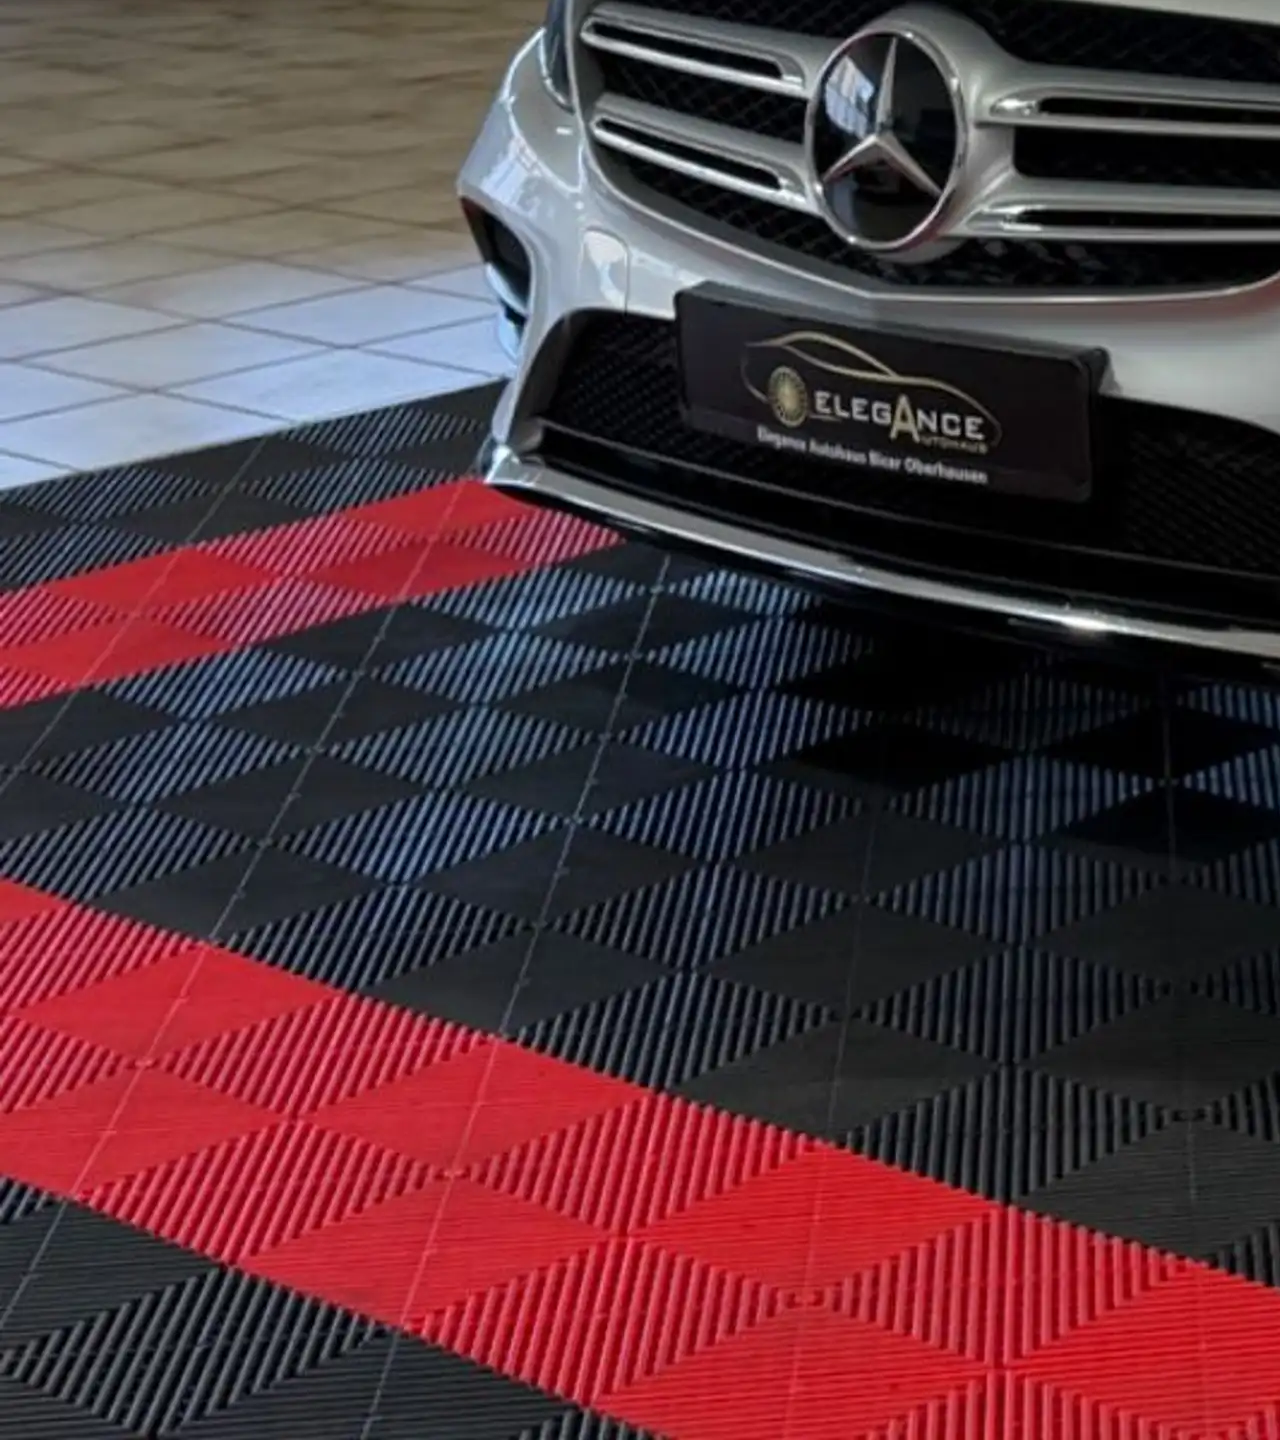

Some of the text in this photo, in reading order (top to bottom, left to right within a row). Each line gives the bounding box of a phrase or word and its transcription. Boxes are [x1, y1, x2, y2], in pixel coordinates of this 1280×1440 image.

[814, 391, 985, 443] ELEGANCE
[809, 438, 867, 465] Autohaus
[903, 456, 988, 484] Oberhausen
